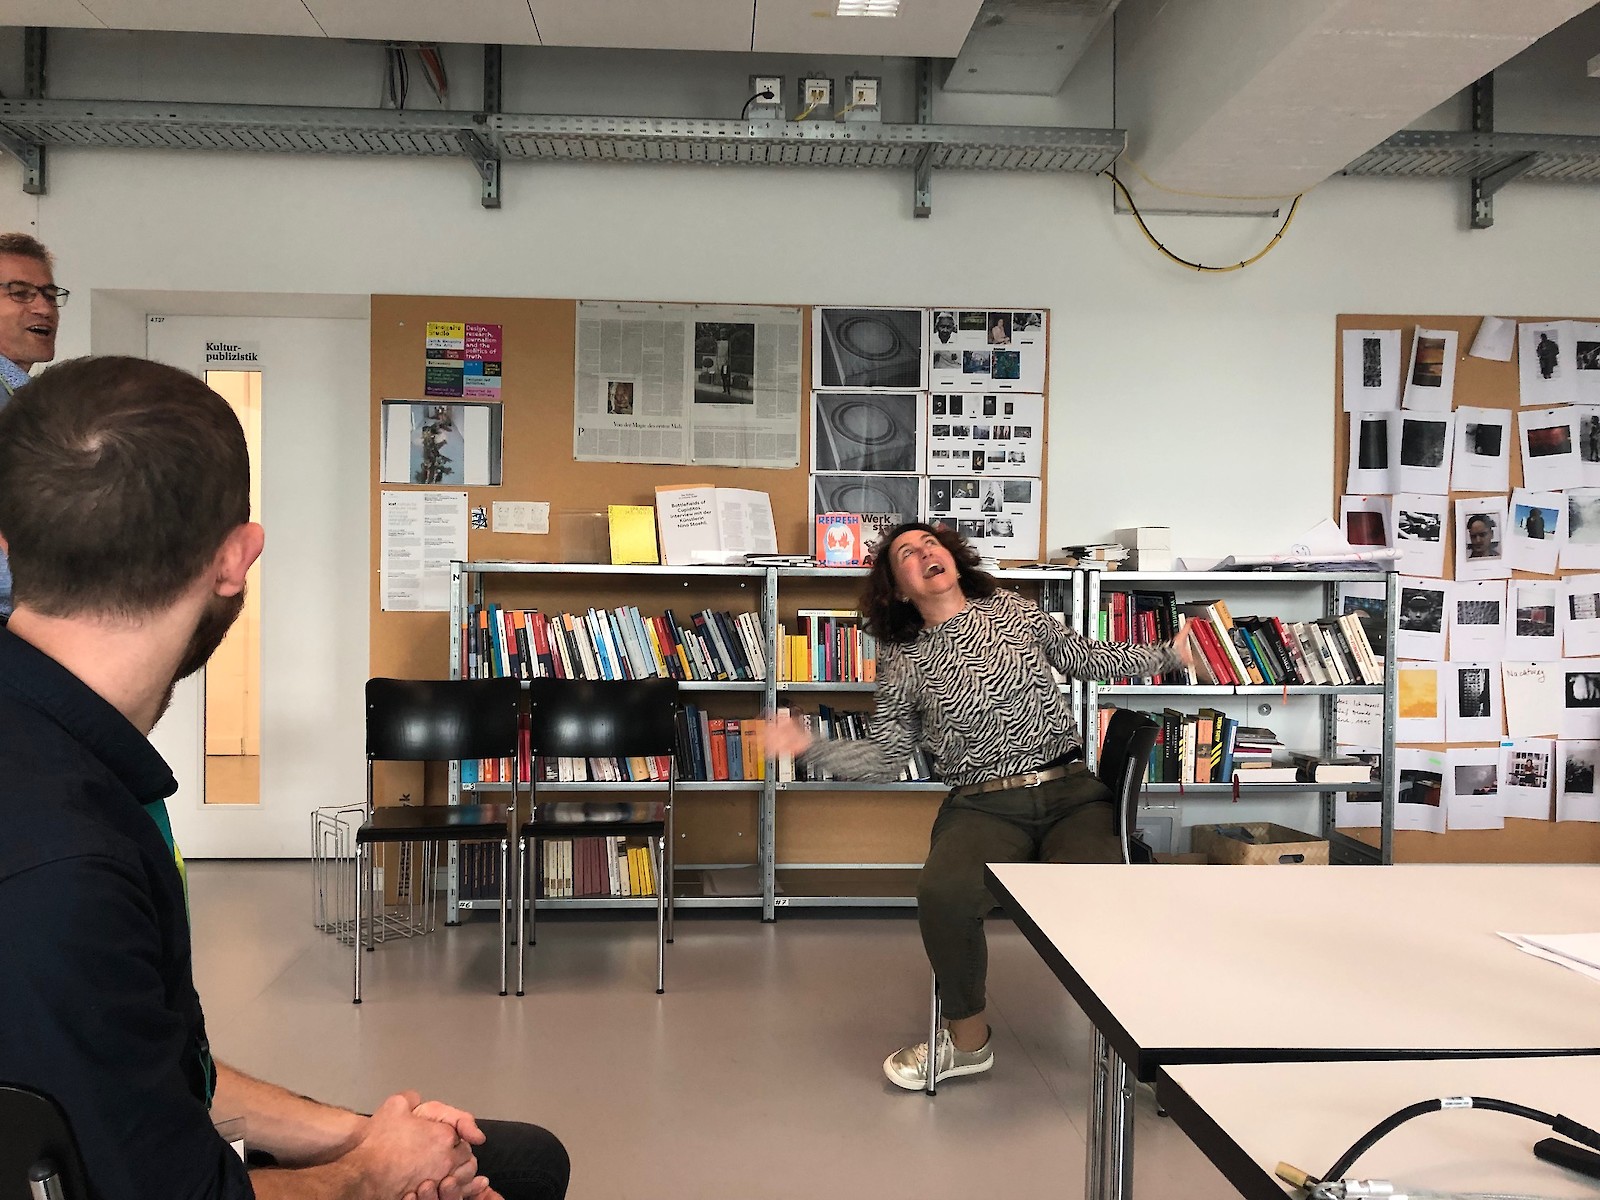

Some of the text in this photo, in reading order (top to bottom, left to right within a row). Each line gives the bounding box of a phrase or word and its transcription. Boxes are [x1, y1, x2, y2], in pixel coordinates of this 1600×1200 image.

[206, 342, 241, 351] Kultur-
[206, 352, 258, 362] publizistik
[578, 428, 584, 436] P
[818, 516, 858, 524] REFRESH
[861, 514, 890, 523] Werk
[1170, 599, 1179, 628] WARHOL
